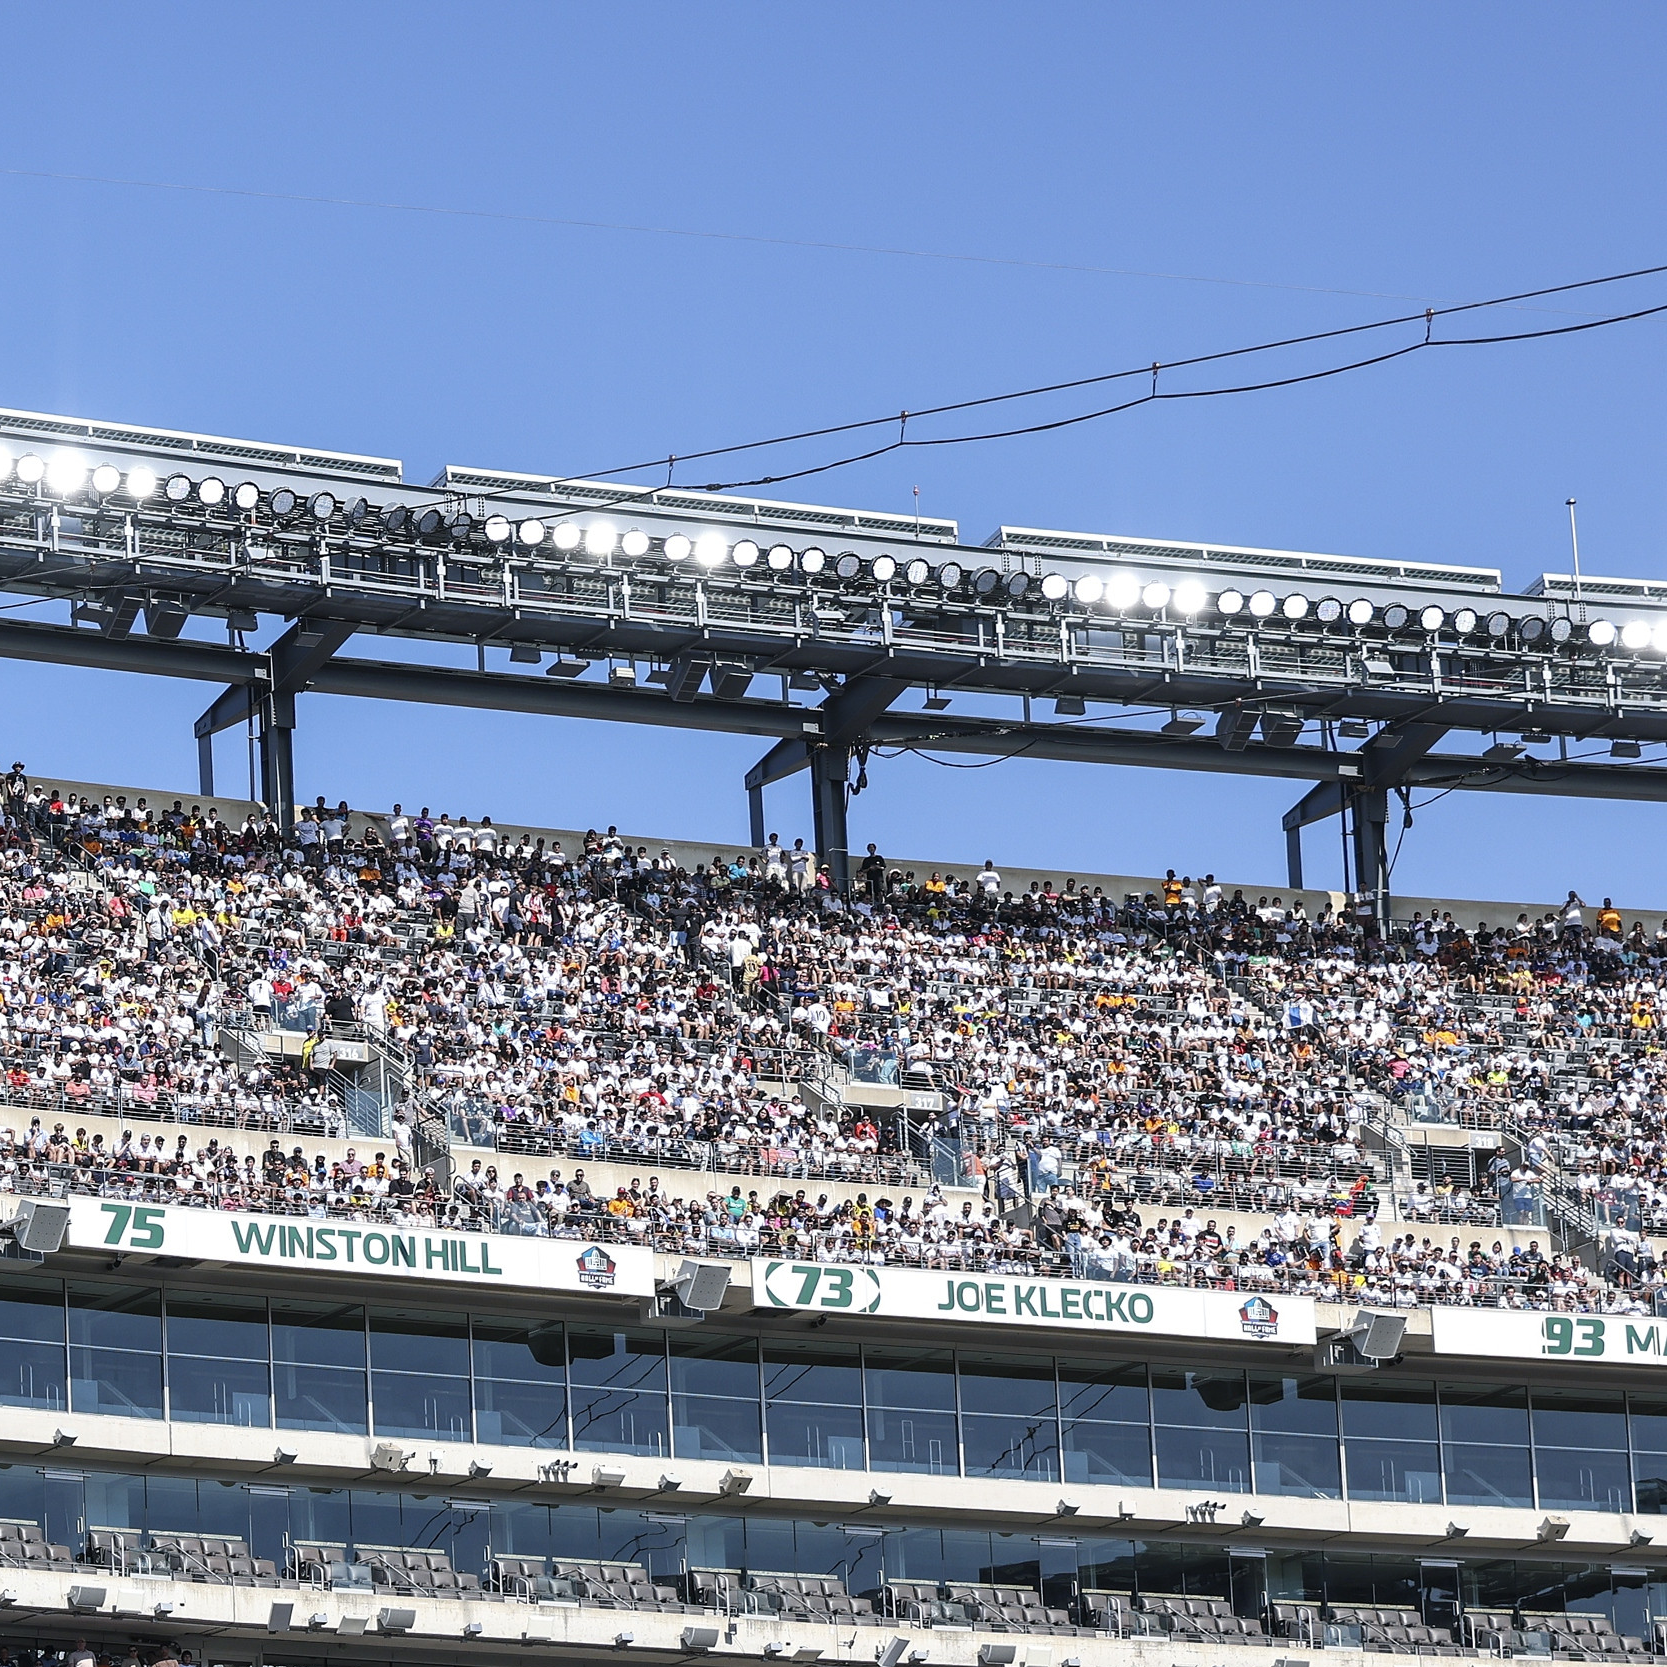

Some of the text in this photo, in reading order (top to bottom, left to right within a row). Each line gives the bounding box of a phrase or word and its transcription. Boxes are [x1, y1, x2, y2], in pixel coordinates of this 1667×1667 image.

[340, 1048, 358, 1059] 316
[915, 1097, 934, 1108] 317
[100, 1204, 502, 1275] 75 WINSTON HILL
[792, 1267, 1153, 1323] 73 JOE KLECKO
[1541, 1317, 1667, 1356] 93 M
